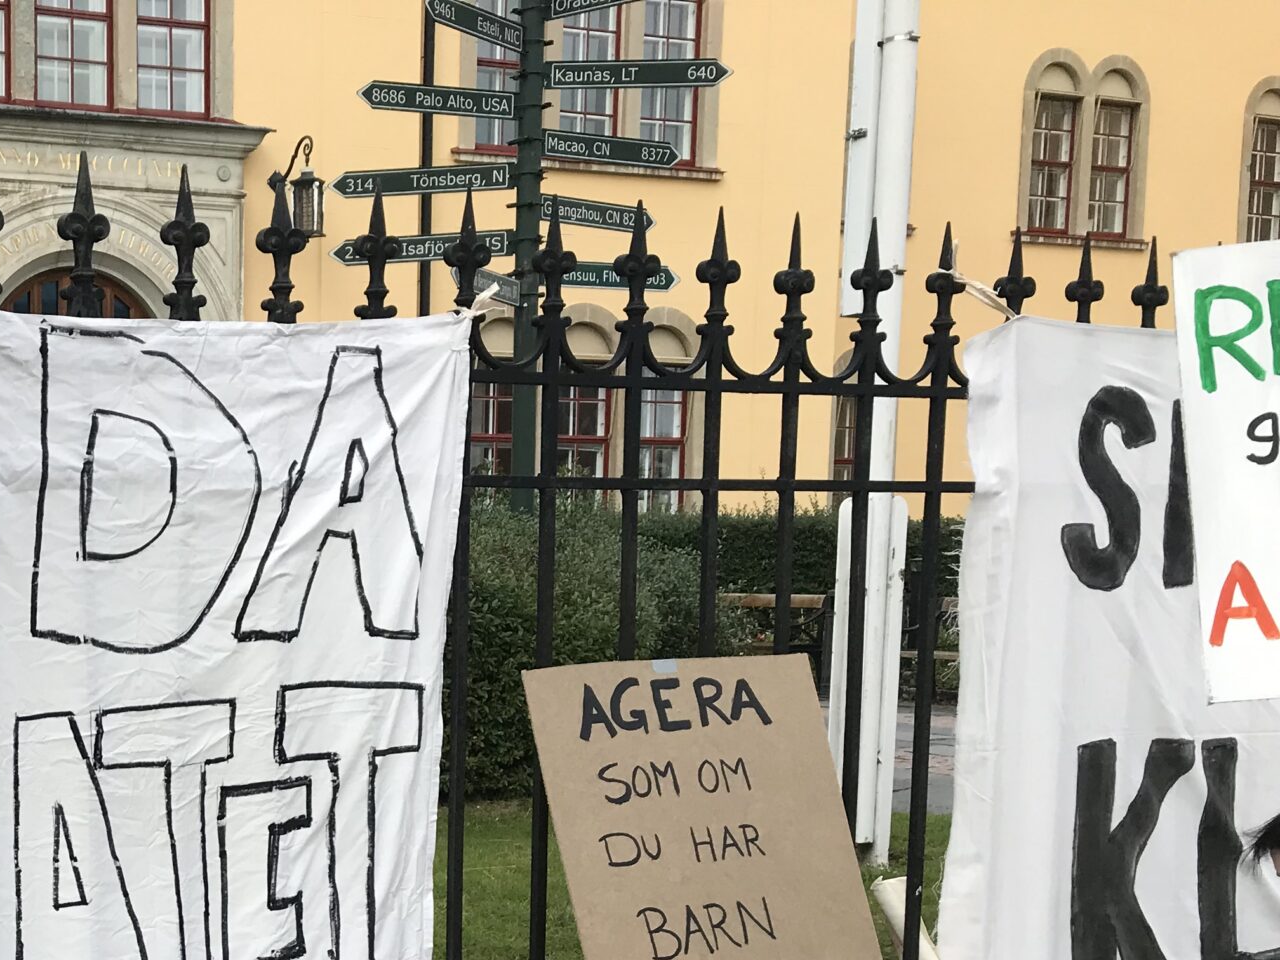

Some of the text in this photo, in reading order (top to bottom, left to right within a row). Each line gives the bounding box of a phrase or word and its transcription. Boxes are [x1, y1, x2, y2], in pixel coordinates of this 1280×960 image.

[433, 0, 456, 21] 9461
[504, 27, 521, 45] NIC
[555, 66, 717, 84] Kaunas, LT 640
[372, 88, 510, 112] 8686 Palo Alto, USA
[548, 136, 671, 162] Macao, CN 8377
[345, 169, 503, 192] 314 Tönsberg, N
[544, 201, 603, 224] Gangzhou,
[606, 210, 620, 224] CN
[603, 270, 621, 283] FIN
[580, 677, 773, 742] AGERA
[597, 757, 752, 805] SOM OM
[598, 823, 766, 868] DU HAR
